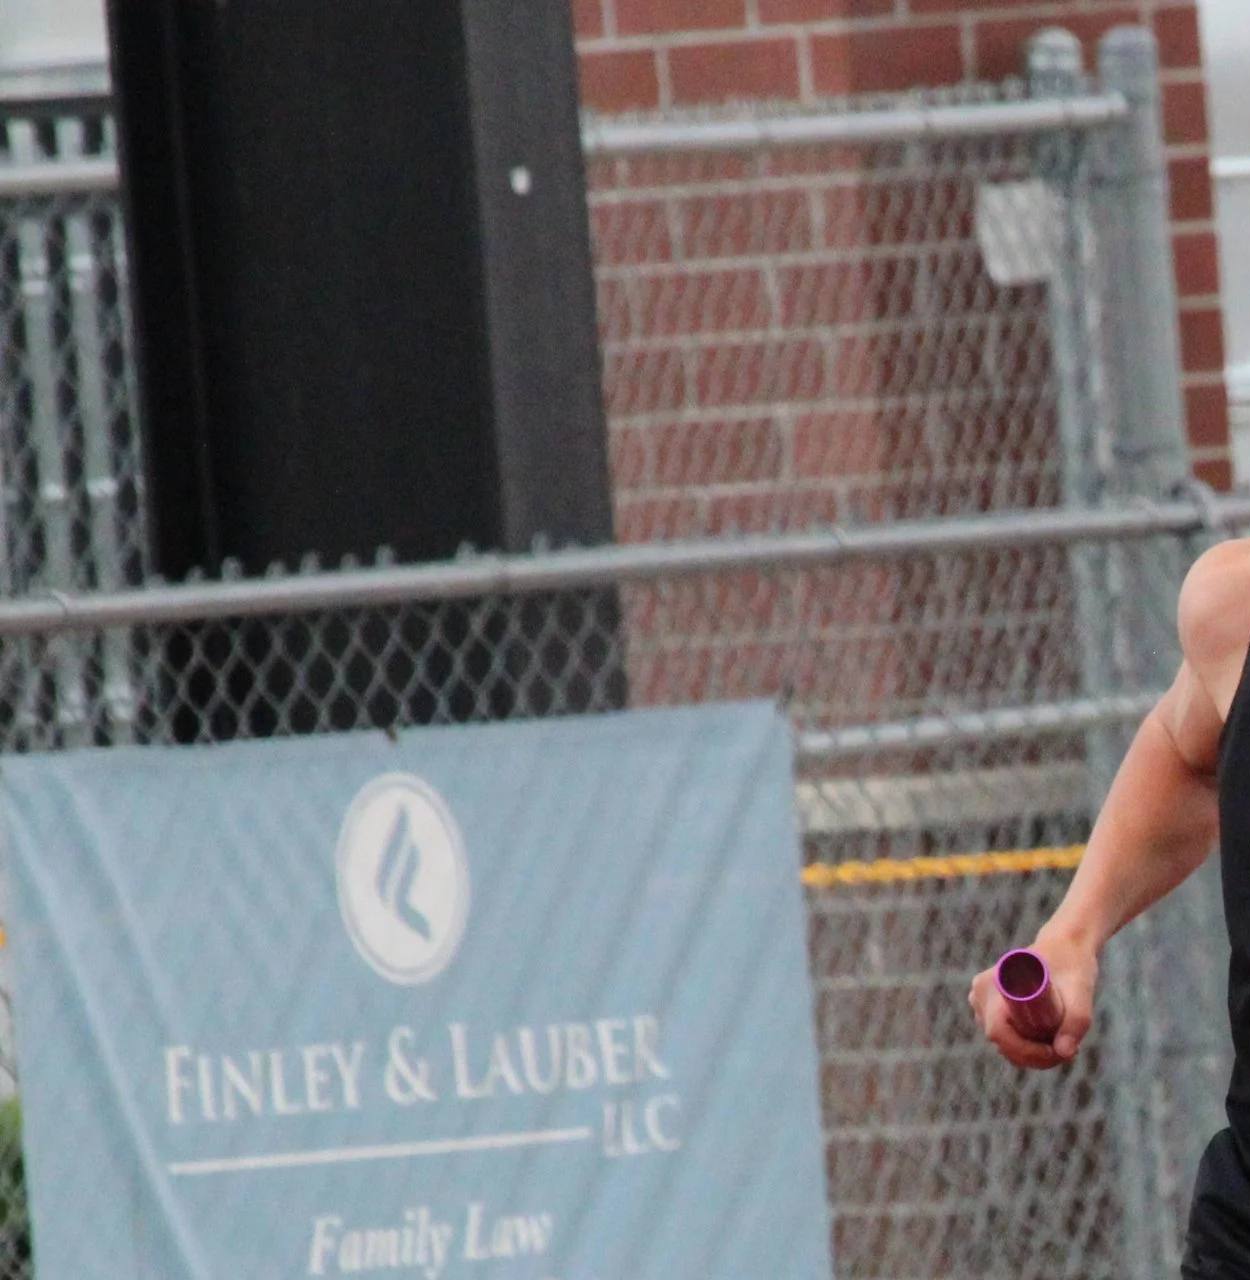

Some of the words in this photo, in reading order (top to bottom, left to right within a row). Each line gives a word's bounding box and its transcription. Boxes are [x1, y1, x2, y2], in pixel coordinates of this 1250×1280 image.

[166, 1043, 365, 1126] FINLEY
[384, 1026, 438, 1105] &
[450, 1015, 671, 1099] LAUBER
[603, 1096, 682, 1157] LLC
[307, 1206, 452, 1280] Family
[464, 1204, 553, 1261] Law
